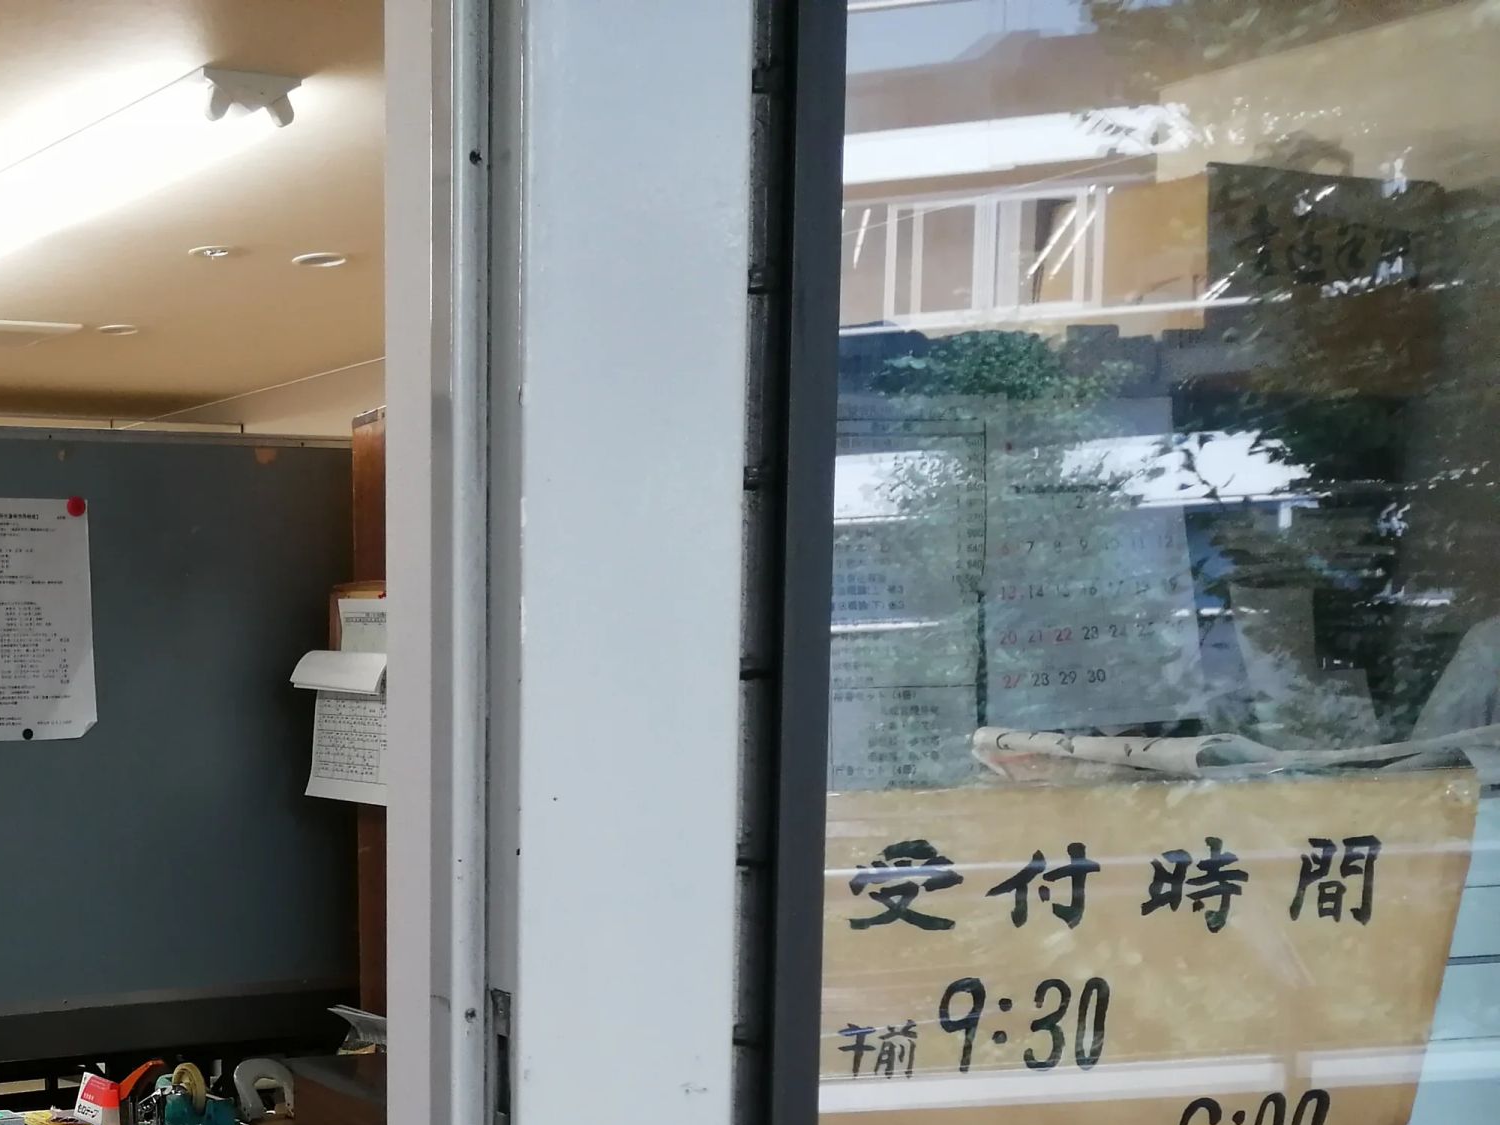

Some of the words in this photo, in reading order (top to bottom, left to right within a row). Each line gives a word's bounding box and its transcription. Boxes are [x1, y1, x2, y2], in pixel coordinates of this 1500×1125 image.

[848, 835, 1383, 933] 受付時間
[836, 1021, 919, 1080] 午前
[938, 976, 1111, 1074] 9:30
